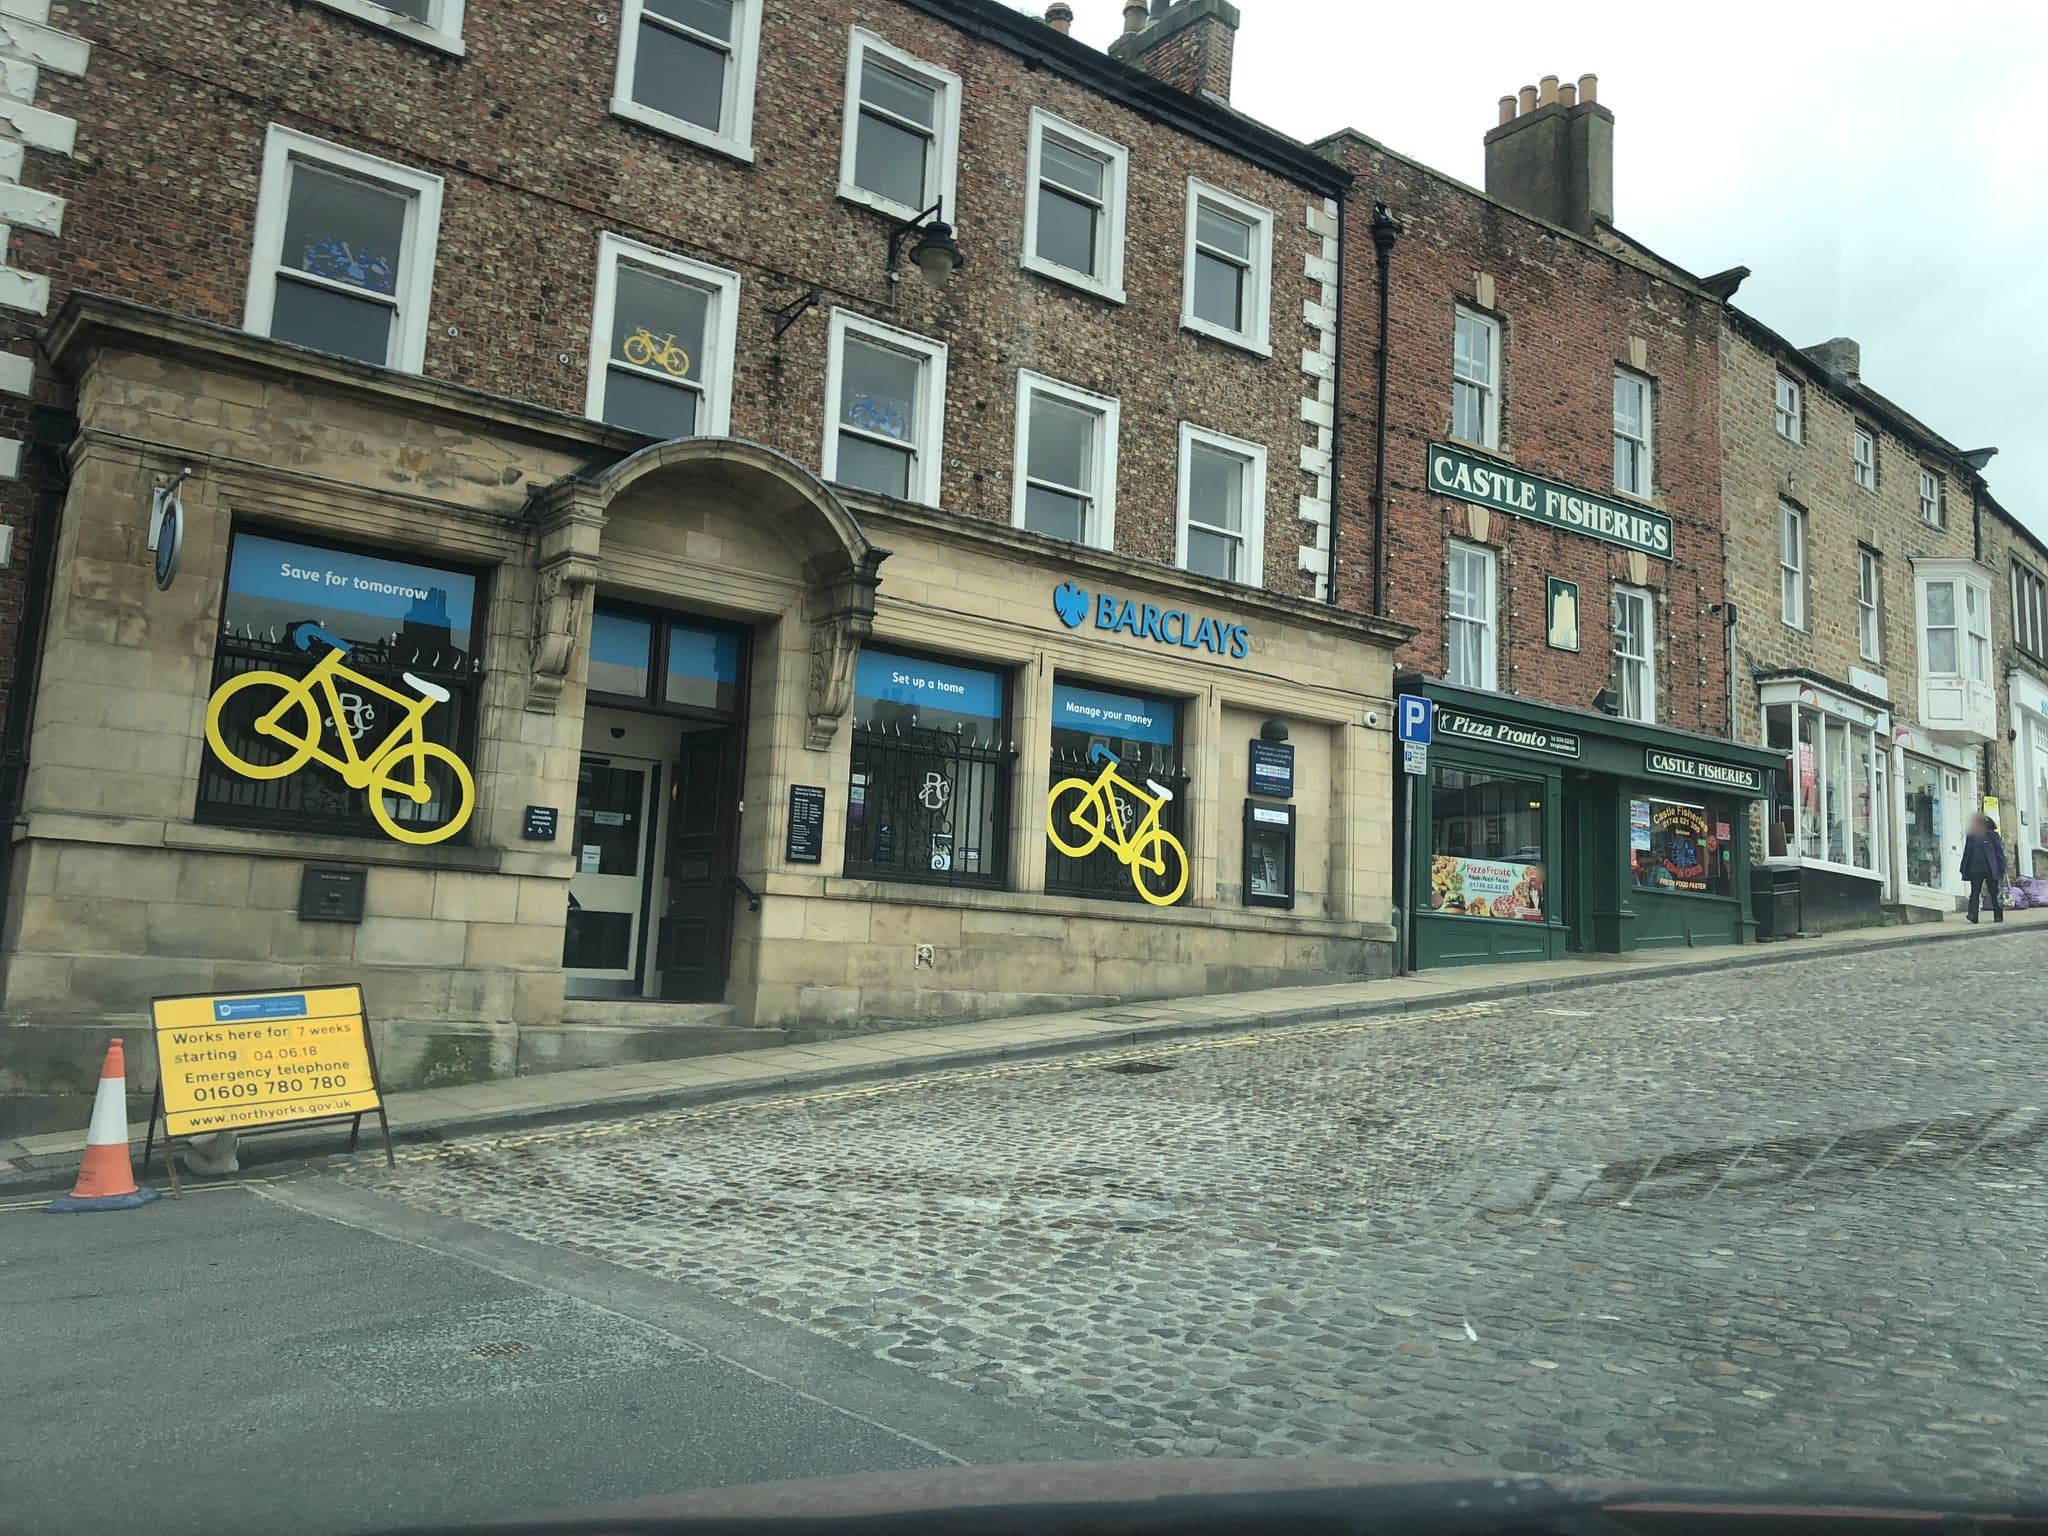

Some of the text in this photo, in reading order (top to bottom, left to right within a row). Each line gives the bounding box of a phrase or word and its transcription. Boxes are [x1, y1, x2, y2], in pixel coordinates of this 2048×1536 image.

[1434, 456, 1668, 551] CASTLE FISHERIES
[280, 563, 428, 601] Save for tomorrow
[1095, 594, 1249, 659] BARCLAYS
[892, 671, 965, 695] Set up a home
[1066, 701, 1153, 727] Manage your money
[1406, 700, 1425, 737] P
[1452, 716, 1493, 737] Pizza
[1497, 725, 1547, 747] Pronto
[1652, 754, 1753, 786] CASTLE FISHERIES
[1653, 806, 1709, 834] Castle Fisheries
[1675, 880, 1689, 889] FOOD
[1689, 881, 1707, 891] FASTER
[173, 1022, 351, 1046] Works here for 7 weeks
[174, 1045, 318, 1065] starting 04.06.18
[185, 1060, 350, 1085] Emergency telephone
[194, 1074, 347, 1102] 01609 780 780
[189, 1098, 352, 1128] www.northyorks.gov.uk
